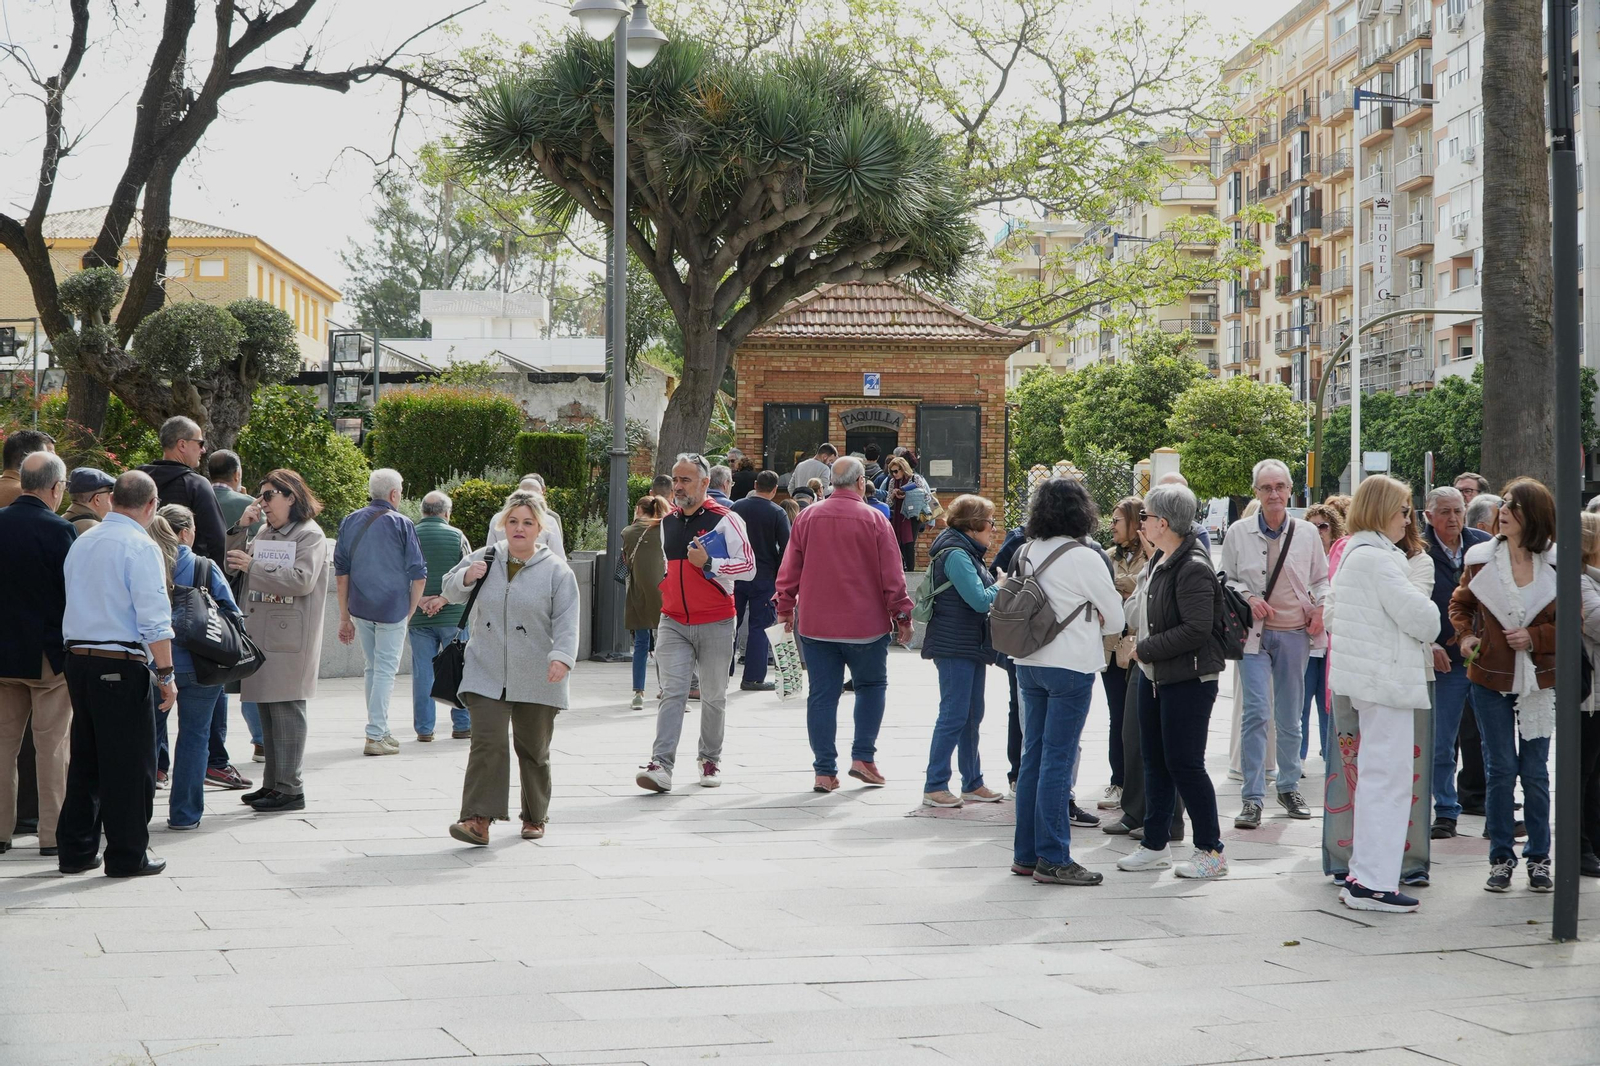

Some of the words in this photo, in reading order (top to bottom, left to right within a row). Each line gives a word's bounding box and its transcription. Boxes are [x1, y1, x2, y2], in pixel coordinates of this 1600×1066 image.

[1378, 223, 1388, 274] HOTEL
[842, 411, 901, 428] TAQUILLA
[258, 552, 290, 560] HUELVA
